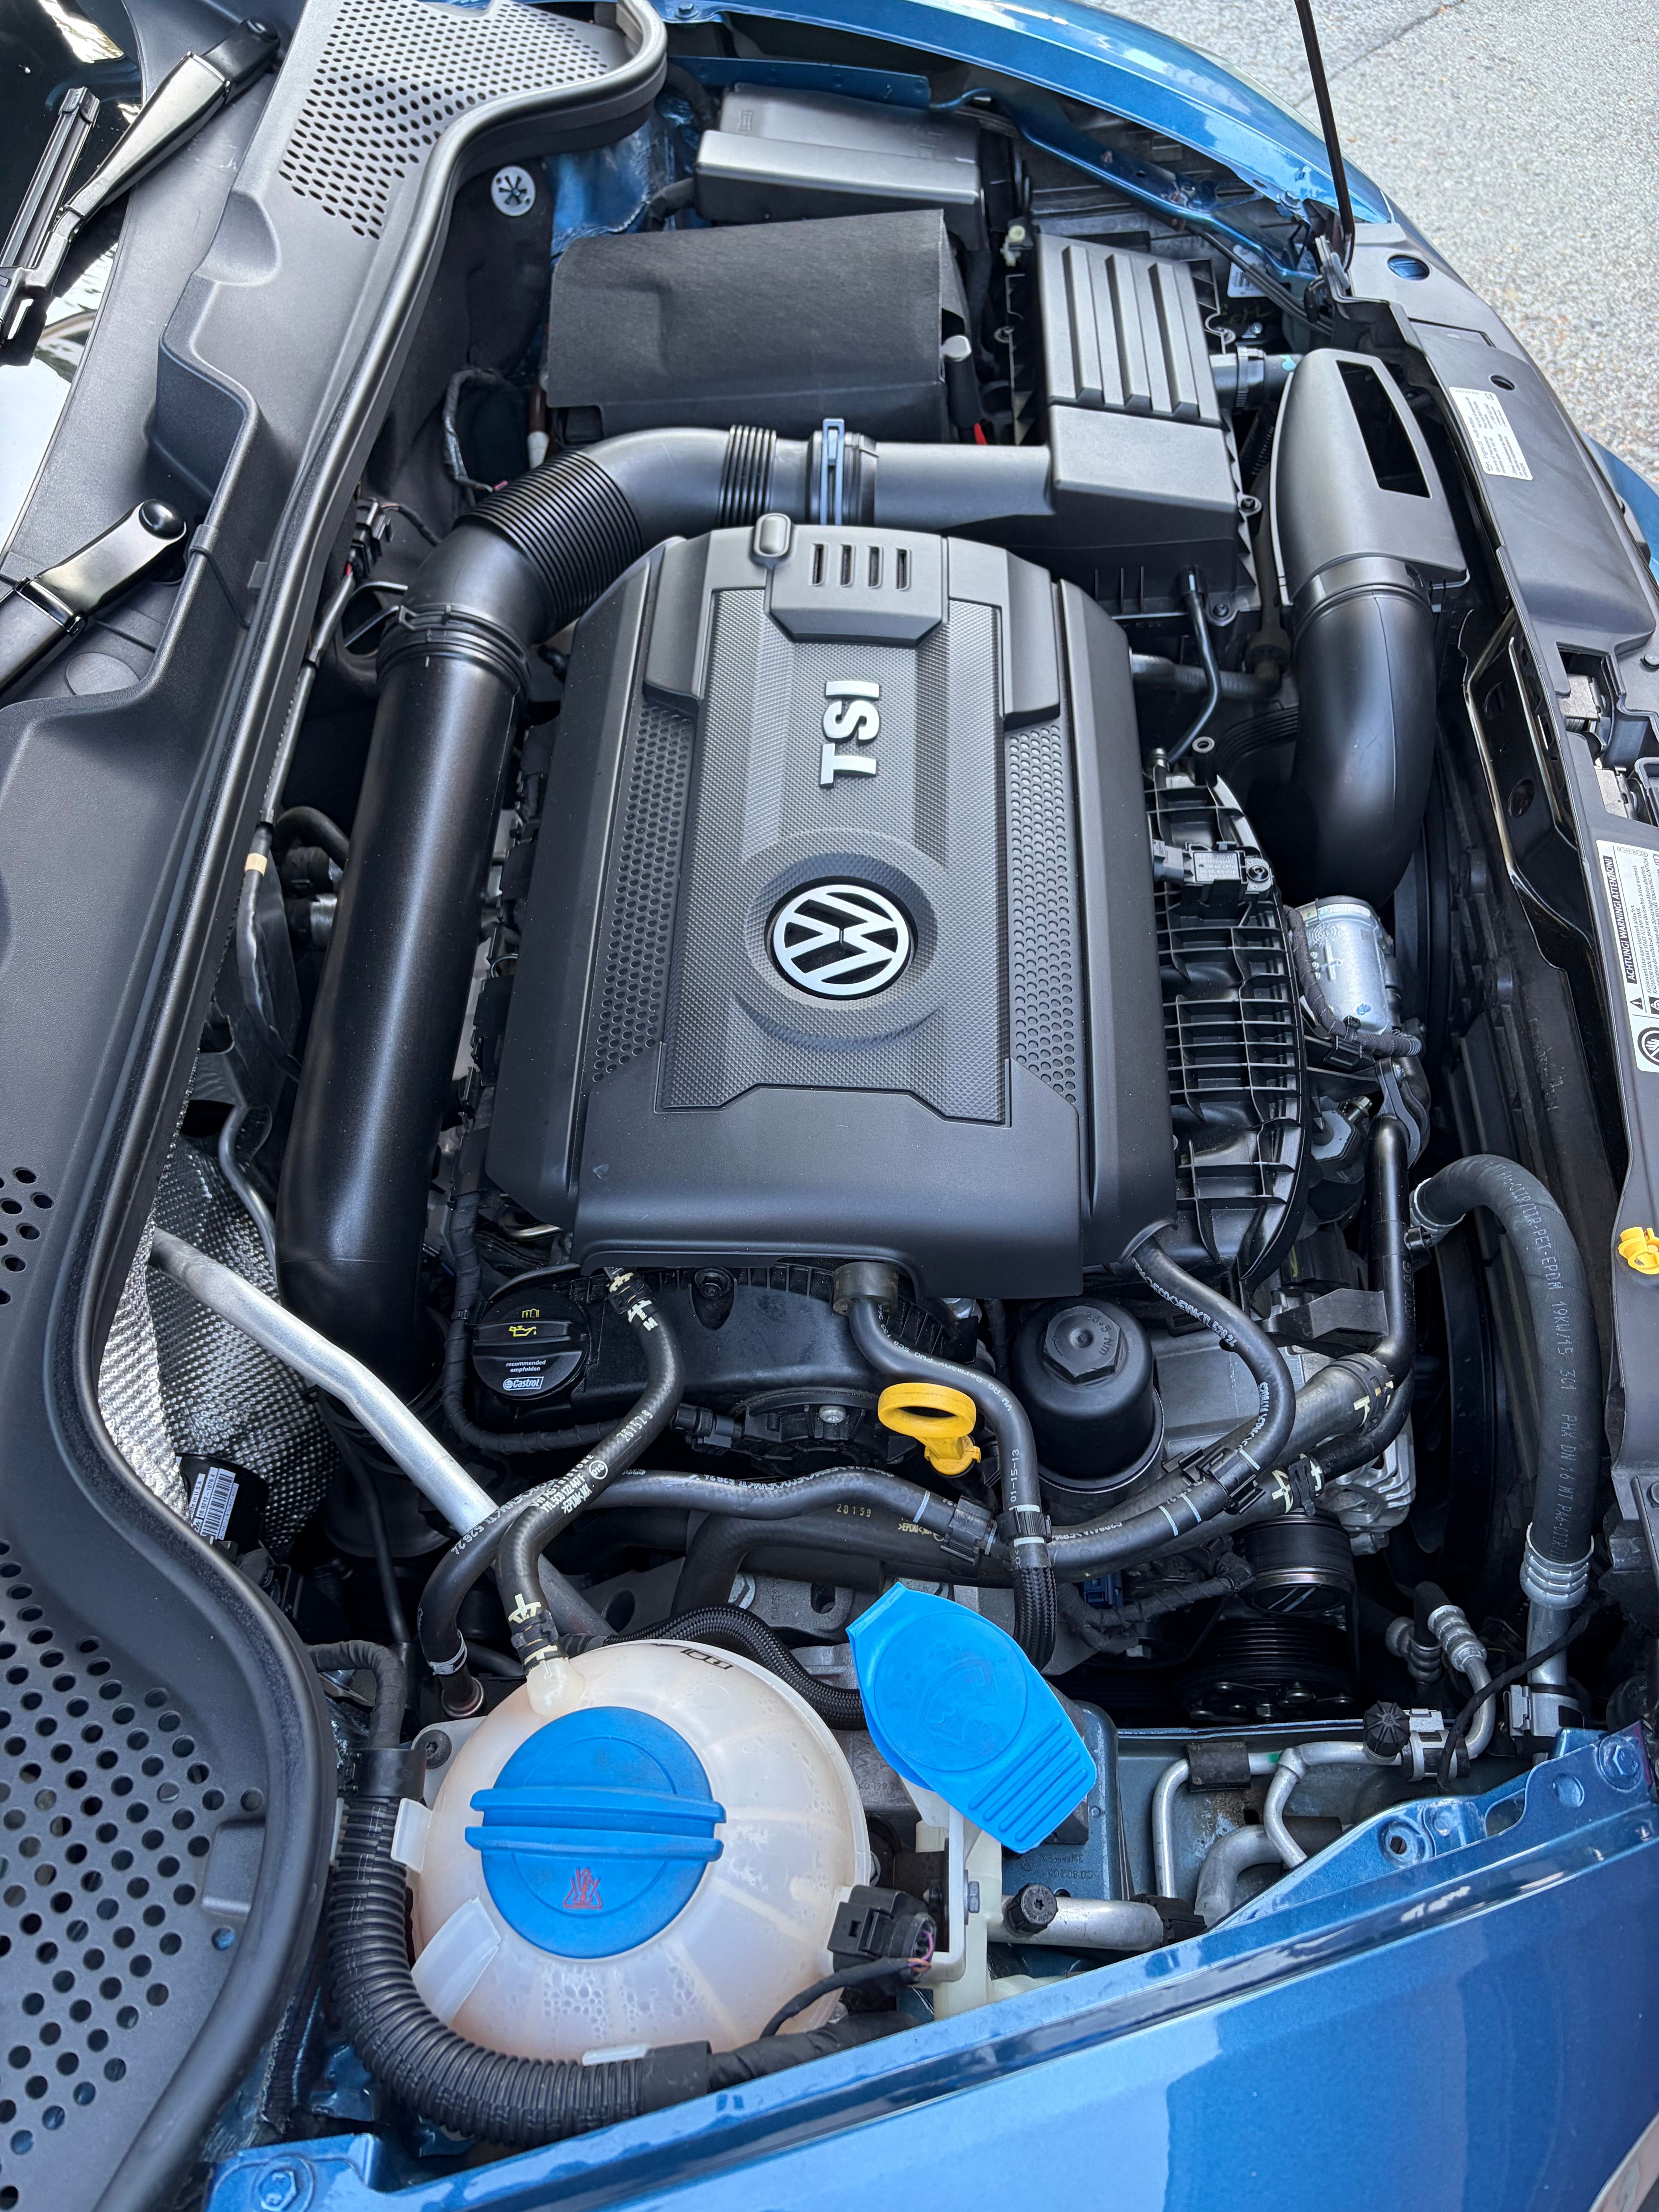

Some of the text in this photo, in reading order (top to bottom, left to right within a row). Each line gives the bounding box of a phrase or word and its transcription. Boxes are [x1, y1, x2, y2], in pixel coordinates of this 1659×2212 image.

[820, 680, 881, 789] TSI
[1648, 878, 1657, 900] TOUCHING
[1605, 858, 1635, 981] ACHTUNG! WARNING! ATTENTION!
[1649, 971, 1657, 994] RADIATOR
[506, 1359, 546, 1367] recommended
[938, 1362, 983, 1384] Germany
[512, 1379, 540, 1388] Castrol
[987, 1382, 1001, 1395] AG
[1560, 1444, 1577, 1461] DN
[552, 1455, 594, 1488] TRISTONE
[576, 1472, 587, 1482] F
[1010, 1449, 1019, 1503] 01-15-13
[1558, 1467, 1577, 1480] 16
